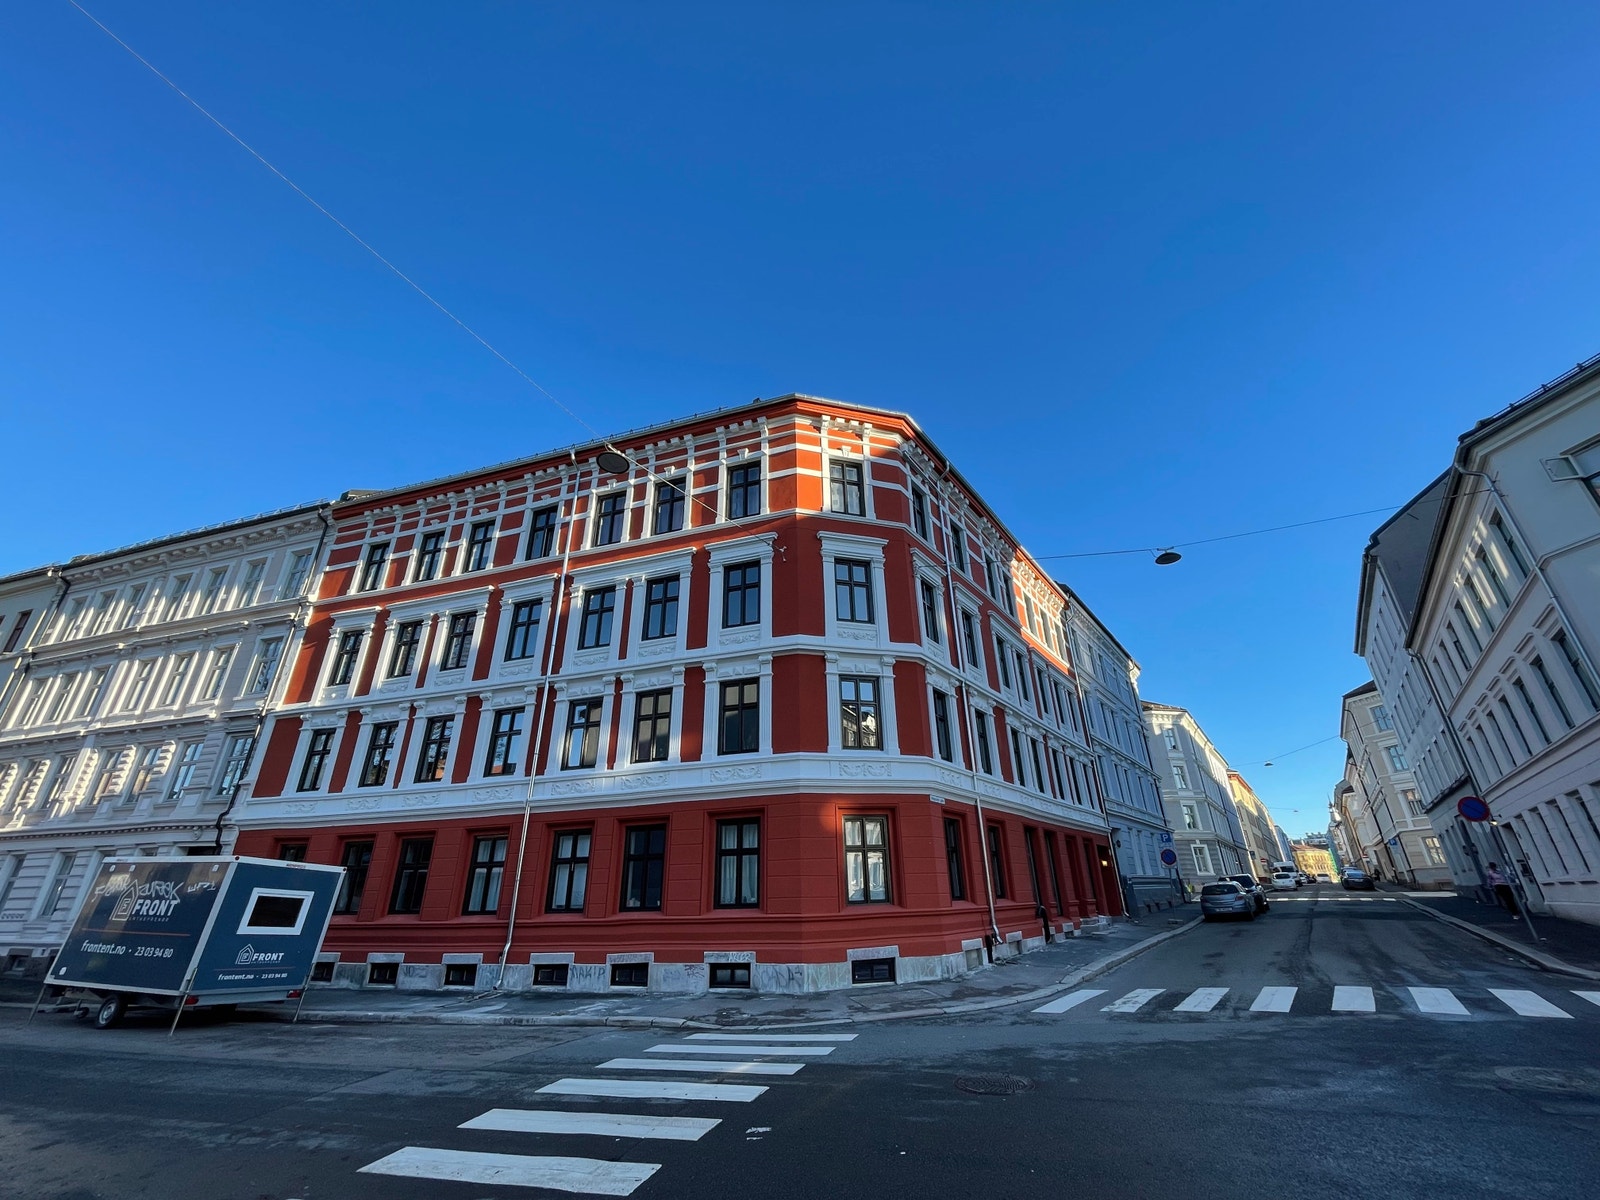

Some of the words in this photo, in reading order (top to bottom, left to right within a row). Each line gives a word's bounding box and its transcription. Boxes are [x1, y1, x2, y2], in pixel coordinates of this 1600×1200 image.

[131, 899, 178, 917] FRONT
[80, 940, 126, 955] frontent.no
[134, 946, 144, 956] 23
[144, 947, 153, 956] 03
[153, 948, 163, 957] 94
[163, 948, 173, 958] 80
[252, 952, 285, 961] FRONT
